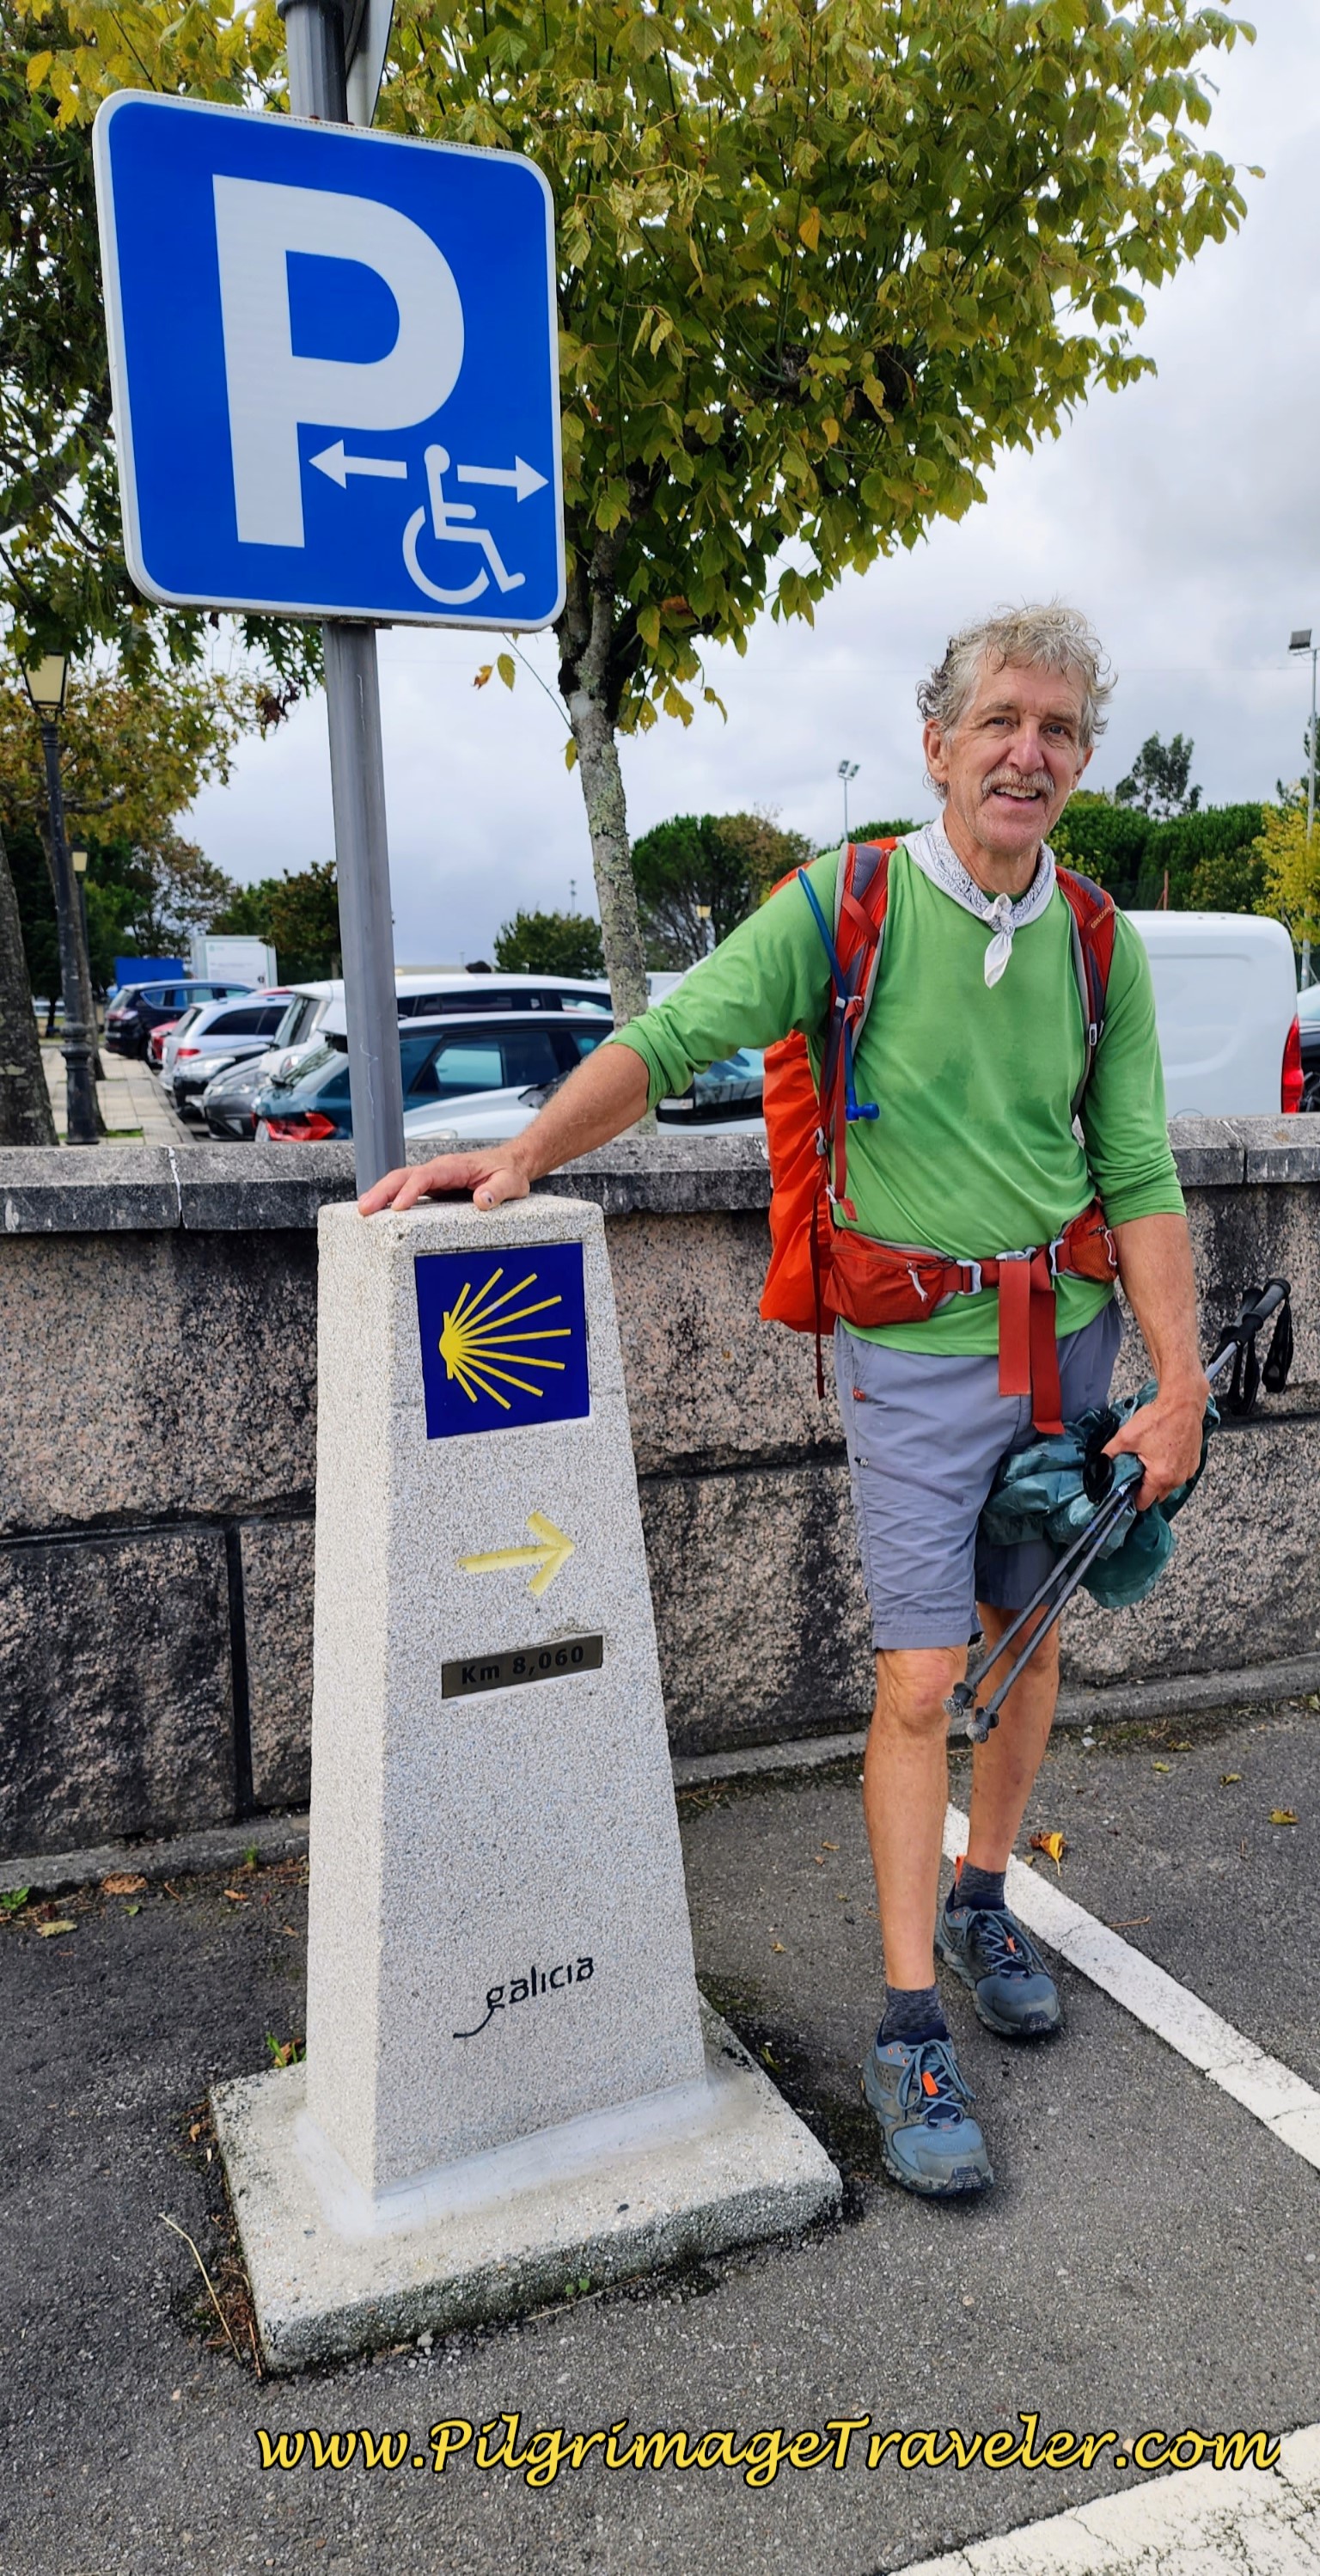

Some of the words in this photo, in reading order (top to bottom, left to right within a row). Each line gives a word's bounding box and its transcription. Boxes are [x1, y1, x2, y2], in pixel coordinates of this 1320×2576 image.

[213, 174, 465, 548] P
[461, 1663, 500, 1686] Km
[512, 1645, 584, 1676] 8,060
[453, 1956, 595, 2038] galicia
